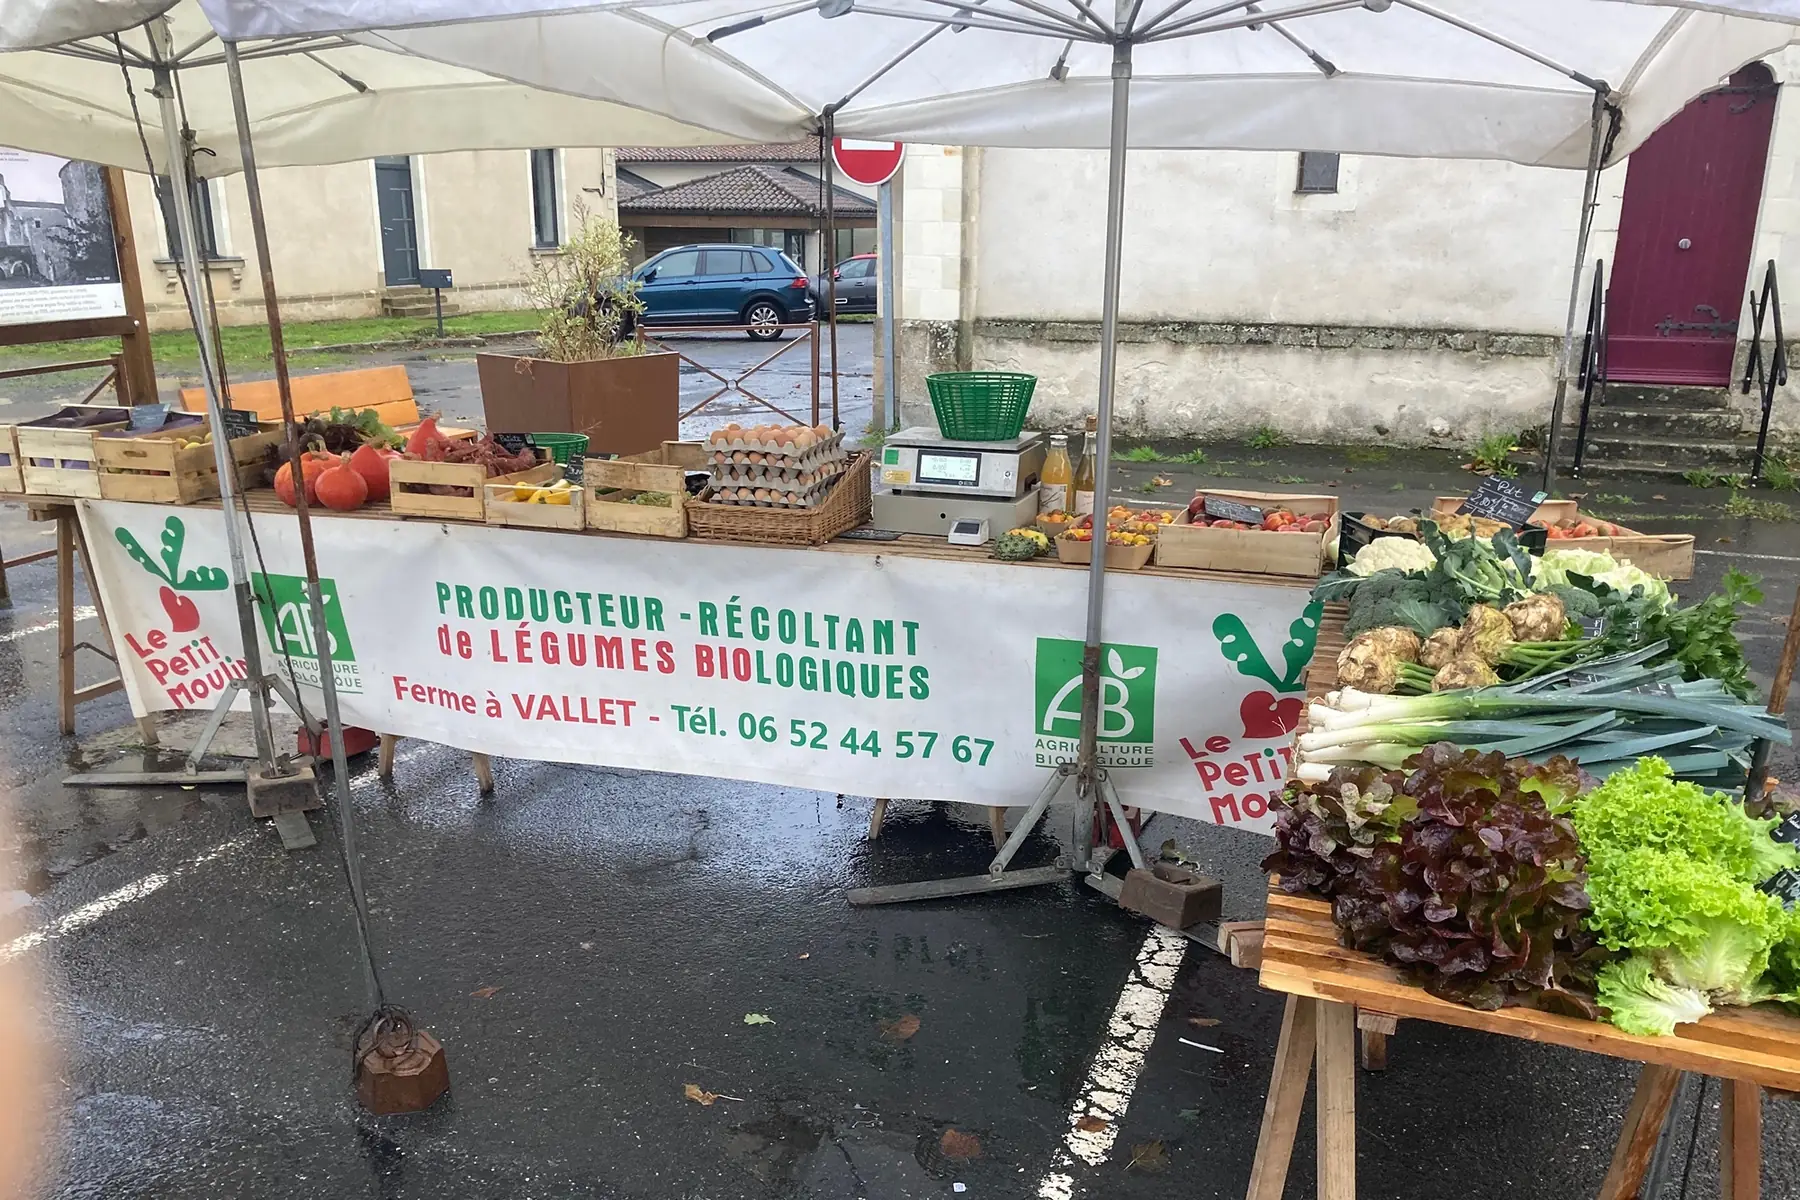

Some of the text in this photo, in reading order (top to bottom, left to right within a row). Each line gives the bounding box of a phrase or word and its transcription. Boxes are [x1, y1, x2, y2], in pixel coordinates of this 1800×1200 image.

[1497, 480, 1523, 498] Pdt
[436, 581, 665, 632] PRODUCTEUR
[124, 629, 168, 659] Le
[278, 657, 360, 675] ARICUURE
[437, 622, 930, 700] de LÉGUMES BIOLOGIQUES
[281, 668, 363, 688] BOLOQUE
[392, 676, 476, 714] Ferme
[485, 690, 502, 719] à
[511, 694, 637, 727] VALLET
[671, 705, 727, 737] Tél.
[738, 712, 778, 743] 06
[790, 719, 828, 750] 52
[840, 727, 881, 758] 44
[895, 731, 938, 759] 57
[952, 735, 995, 767] 67
[1035, 738, 1154, 755] AGRILTURE
[1179, 735, 1231, 760] Le
[1036, 753, 1154, 766] BIOGIQUE
